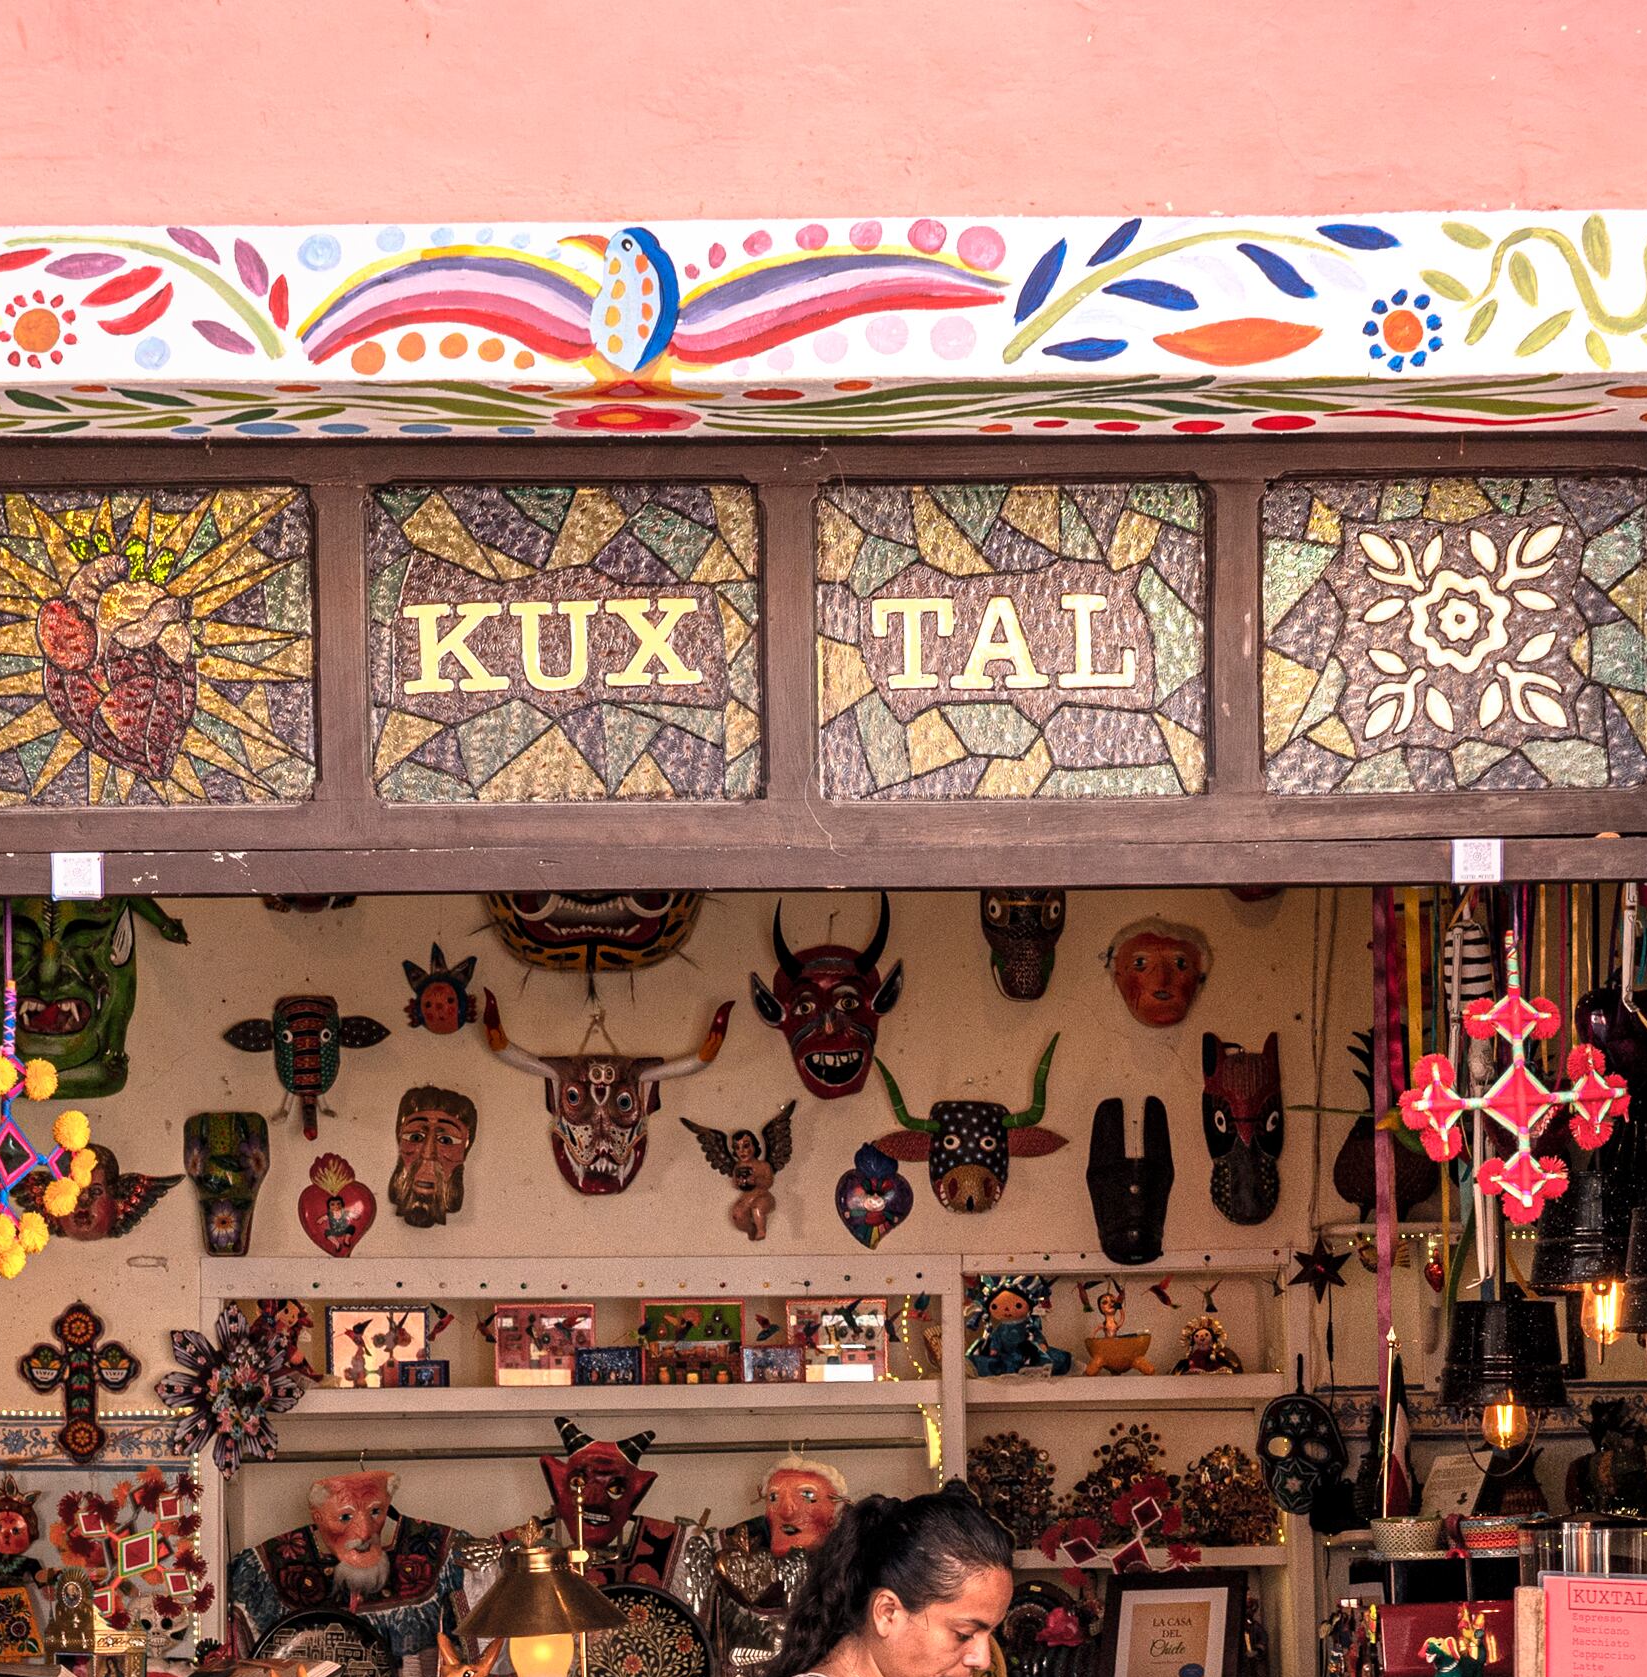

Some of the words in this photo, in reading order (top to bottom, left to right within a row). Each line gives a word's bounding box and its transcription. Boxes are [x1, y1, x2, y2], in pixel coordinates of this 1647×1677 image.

[402, 597, 703, 694] KUX
[872, 592, 1138, 691] TAL
[1574, 1589, 1647, 1606] KUXTAL
[1153, 1619, 1165, 1627] LA
[1167, 1618, 1192, 1627] CASA
[1572, 1613, 1622, 1623] Espresso
[1162, 1630, 1182, 1638] DEL
[1572, 1625, 1630, 1635] Americano
[1572, 1638, 1630, 1648] Macchiato
[1572, 1650, 1636, 1661] Cappuccino
[1572, 1662, 1604, 1671] Latte
